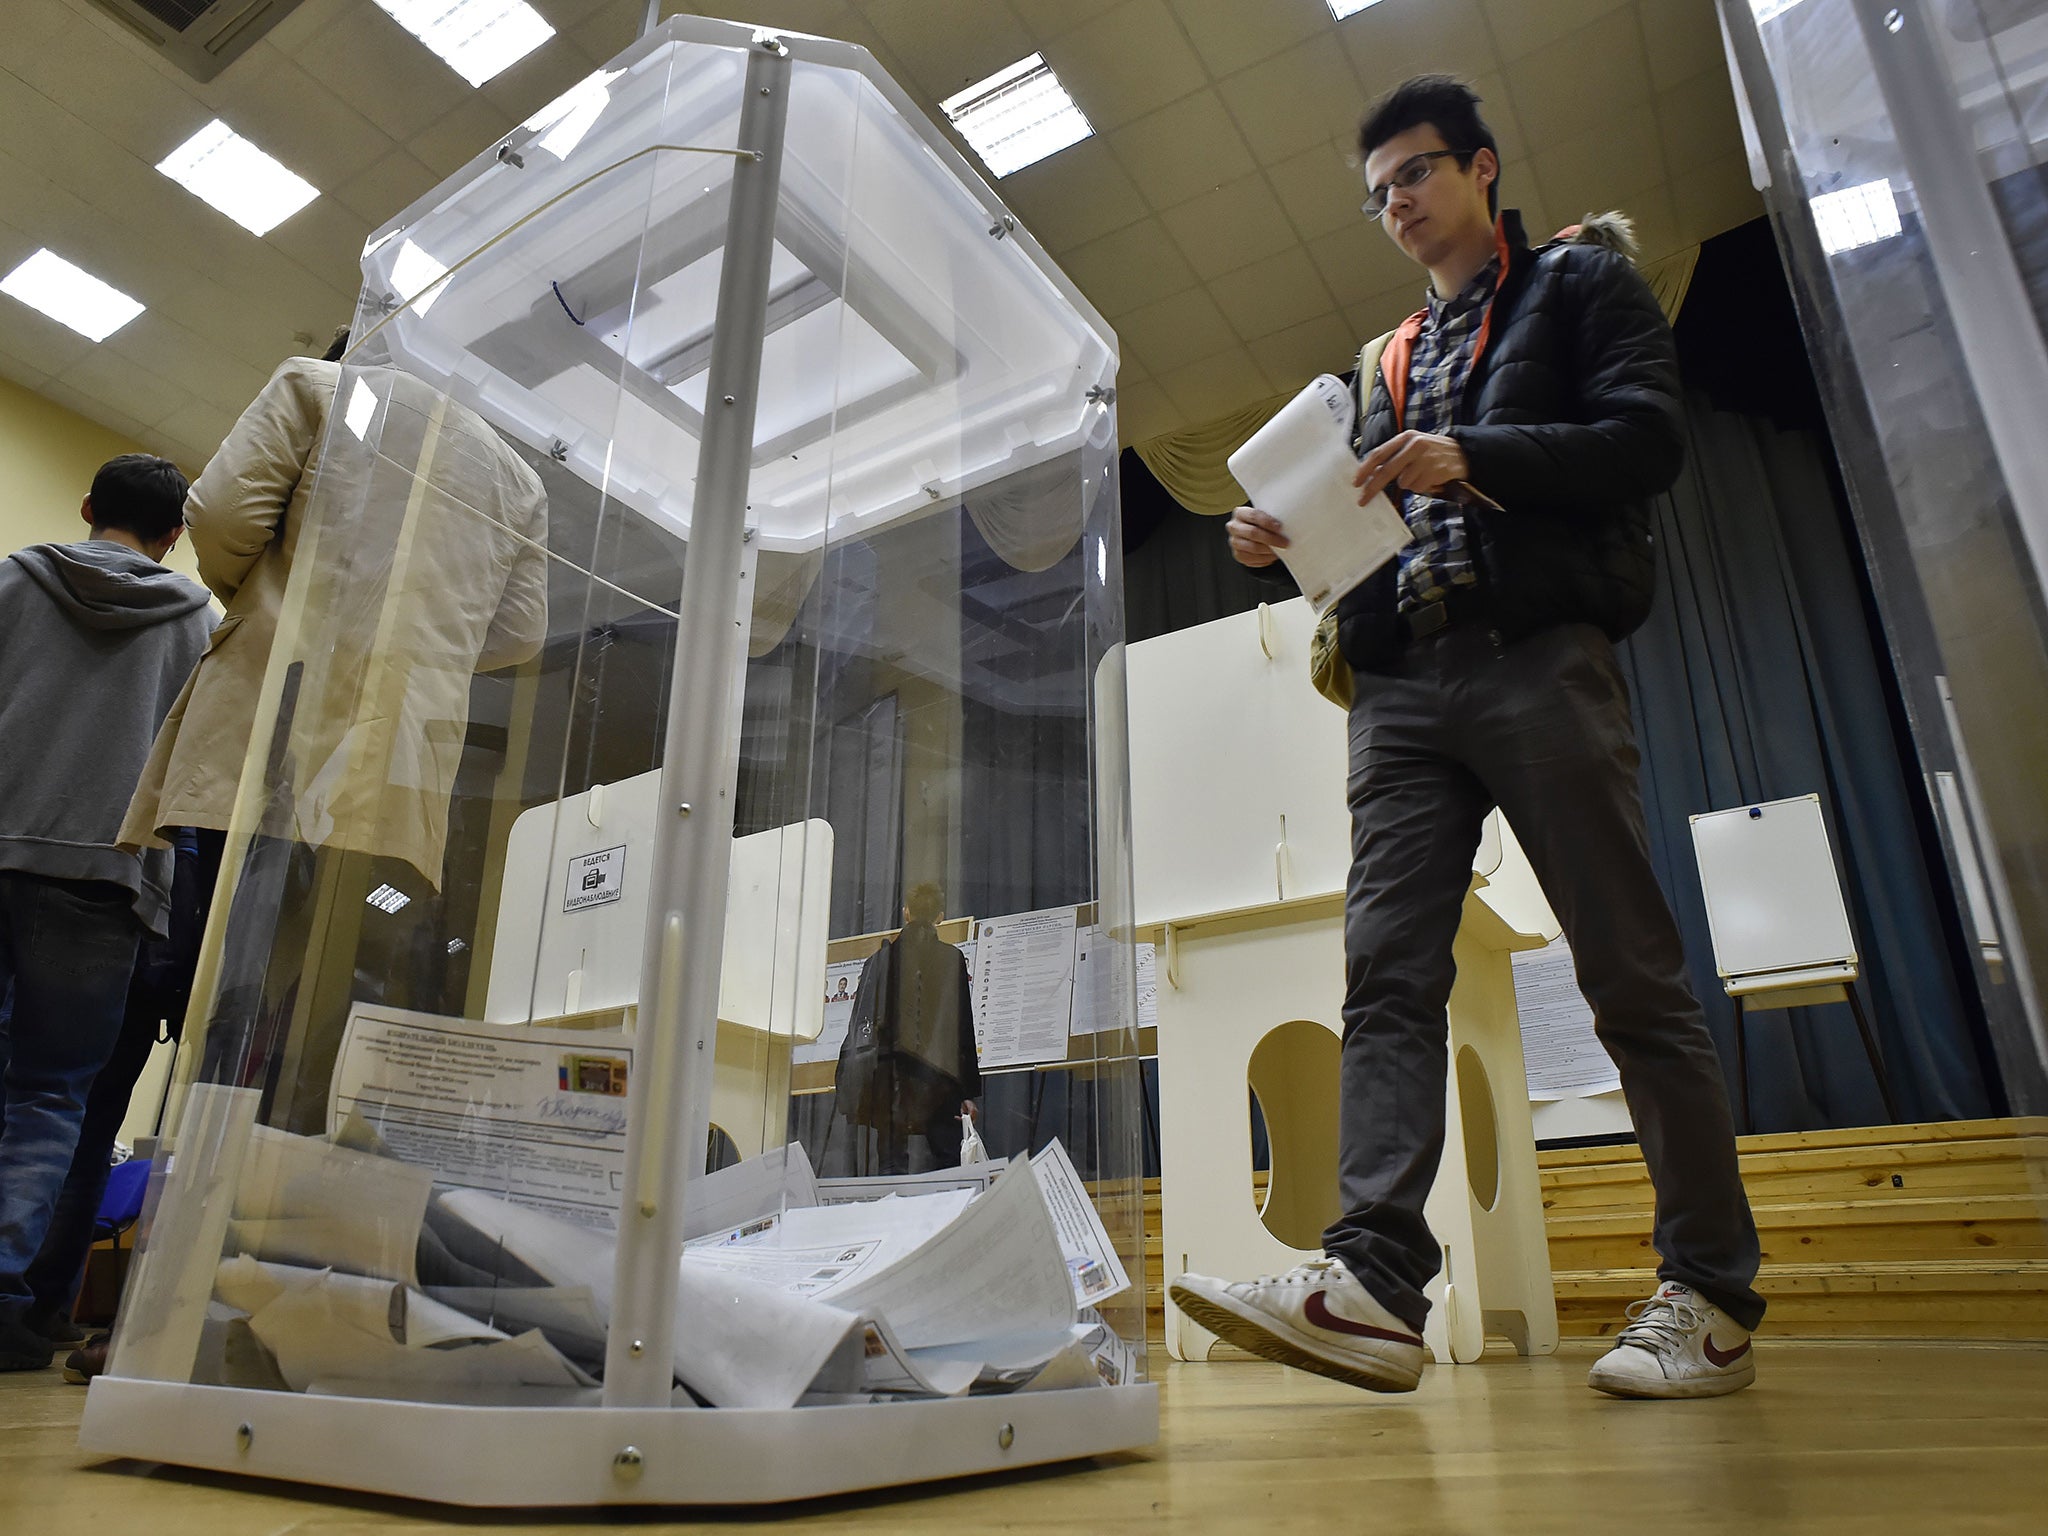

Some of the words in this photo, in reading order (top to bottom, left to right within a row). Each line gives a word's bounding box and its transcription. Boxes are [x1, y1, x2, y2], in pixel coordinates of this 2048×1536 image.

[583, 853, 610, 866] ВЕДЕТСЯ
[566, 888, 618, 907] ВИДЕОНАБЛЮДЕНИЕ
[1670, 1284, 1691, 1294] NIKE
